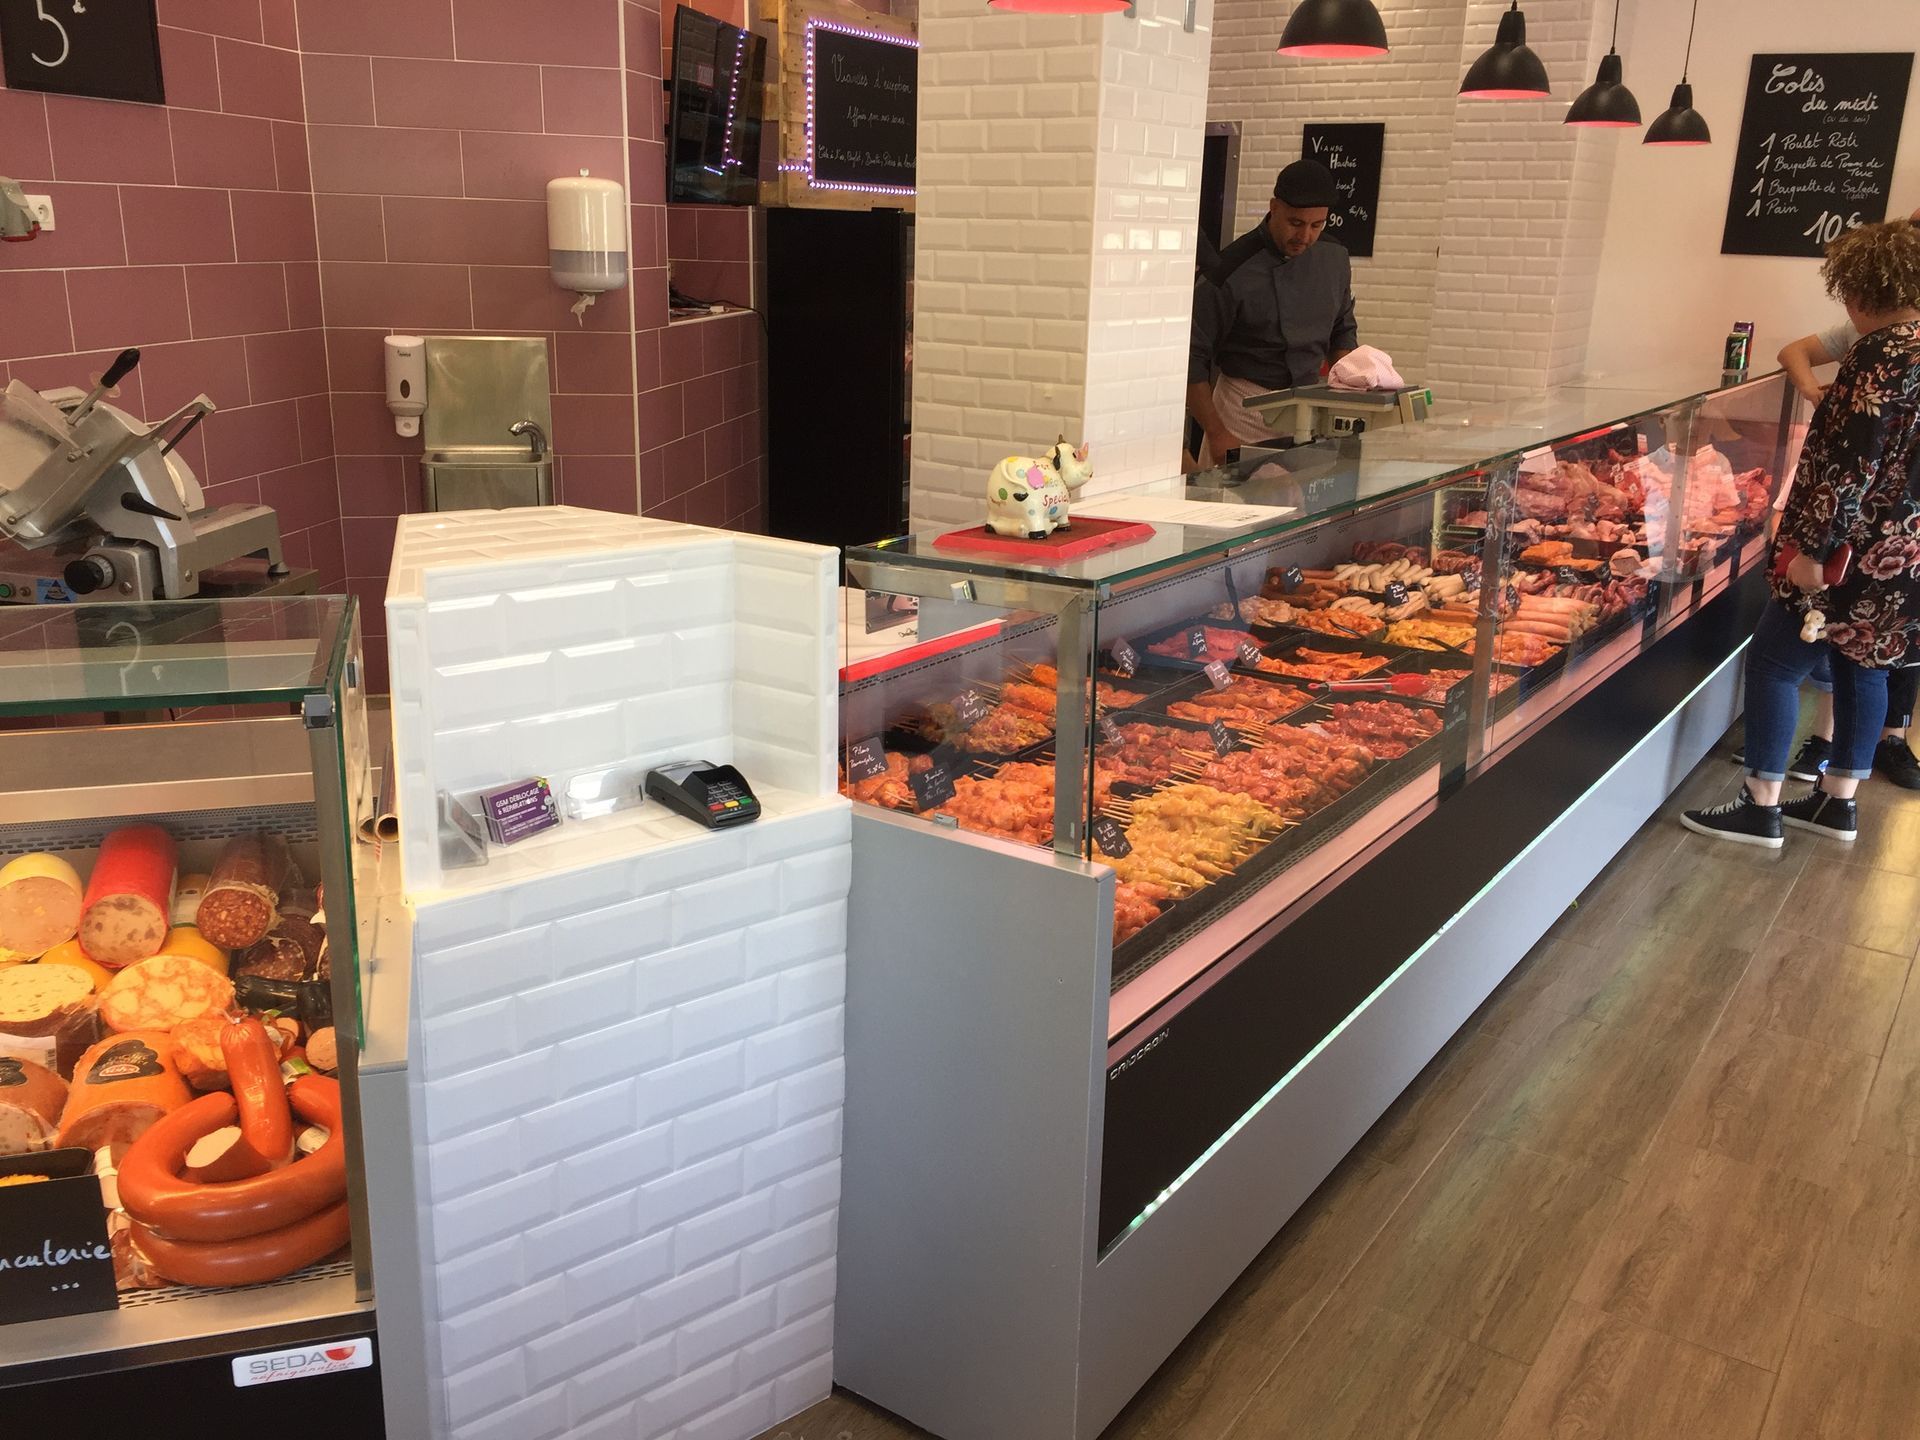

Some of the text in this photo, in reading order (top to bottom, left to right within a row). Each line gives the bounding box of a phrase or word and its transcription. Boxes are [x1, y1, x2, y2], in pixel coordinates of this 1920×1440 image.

[1764, 63, 1825, 94] Colis
[1802, 91, 1879, 112] du midi
[1760, 132, 1776, 153] 1
[1781, 131, 1823, 150] Poulet
[1755, 154, 1770, 174] 1
[1820, 155, 1834, 169] de
[1866, 157, 1885, 169] de
[1750, 177, 1764, 196] 1
[1823, 181, 1836, 194] de
[1841, 179, 1880, 194] Salade
[1746, 197, 1799, 216] 1 Pain
[249, 1351, 328, 1375] SEDA
